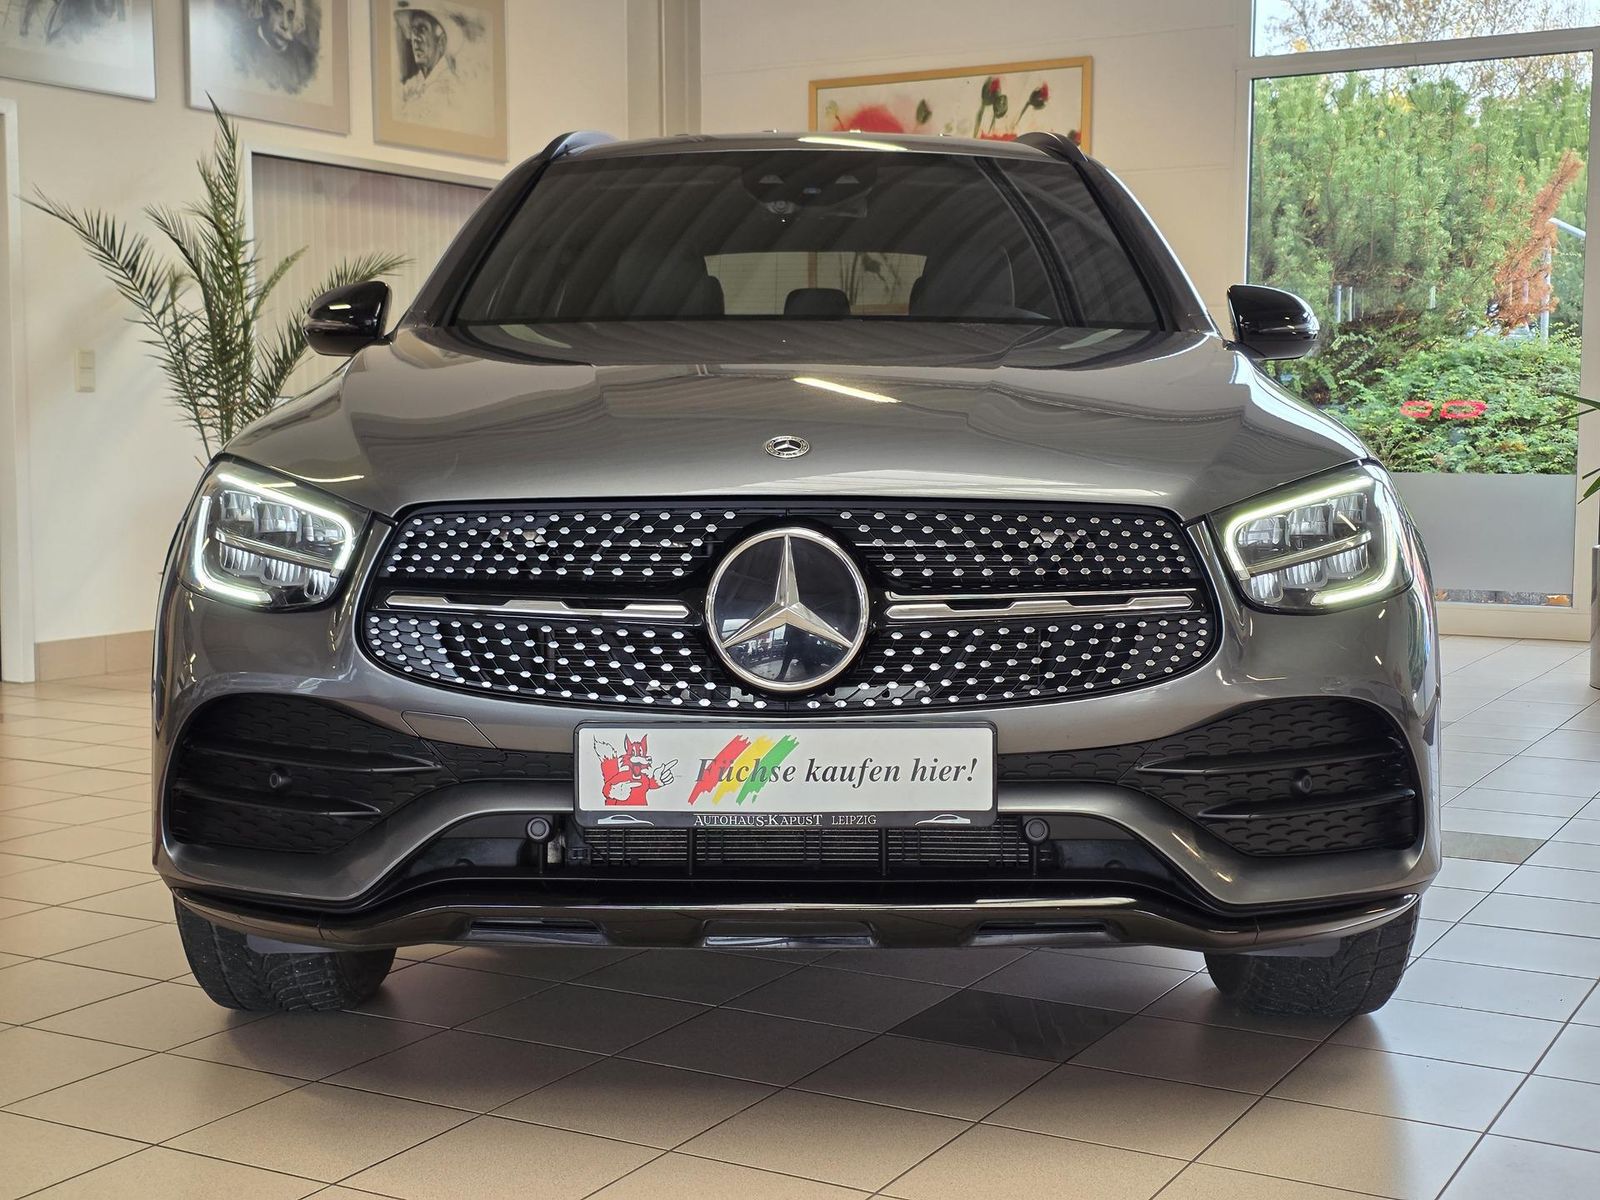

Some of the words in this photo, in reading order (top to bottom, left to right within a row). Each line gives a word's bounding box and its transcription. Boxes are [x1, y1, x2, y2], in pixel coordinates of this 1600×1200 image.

[696, 757, 796, 783] Füchse
[804, 757, 901, 789] kaufen
[910, 757, 978, 782] hier!
[831, 814, 877, 826] LEIPZIG
